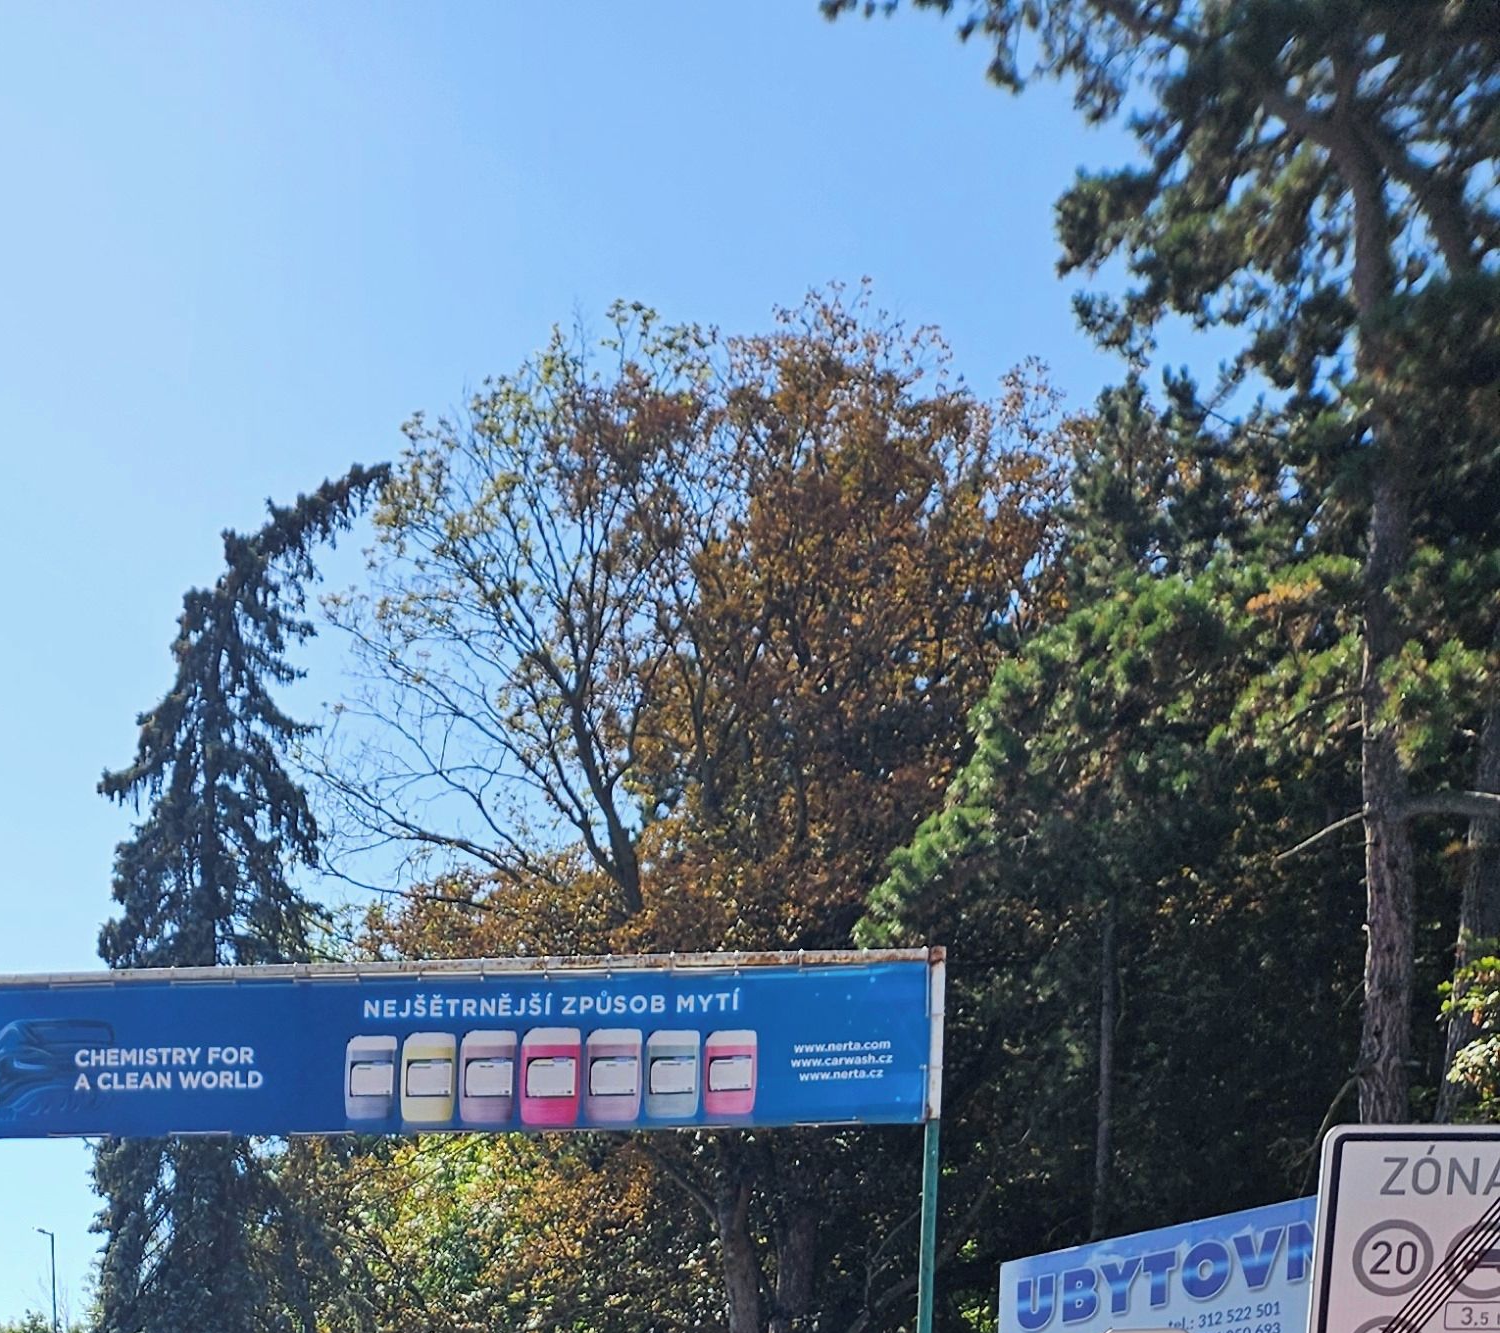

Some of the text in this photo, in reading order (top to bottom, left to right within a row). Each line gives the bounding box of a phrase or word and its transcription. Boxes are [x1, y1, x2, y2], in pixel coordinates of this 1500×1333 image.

[363, 987, 741, 1019] NEJŠĚTRNĚJŠÍ ZPŮSOB MYTÍ
[74, 1046, 255, 1067] CHEMISTRY FOR
[793, 1040, 891, 1054] www.nerta.com
[790, 1053, 893, 1068] www.carwash.cz
[74, 1070, 264, 1091] A CLEAN WORLD
[799, 1068, 884, 1082] www.nerta.cz
[1369, 1240, 1418, 1275] 20
[1015, 1220, 1315, 1332] UBYTOVN
[1198, 1311, 1223, 1328] 312
[1227, 1306, 1252, 1324] 522
[1256, 1301, 1281, 1318] 501
